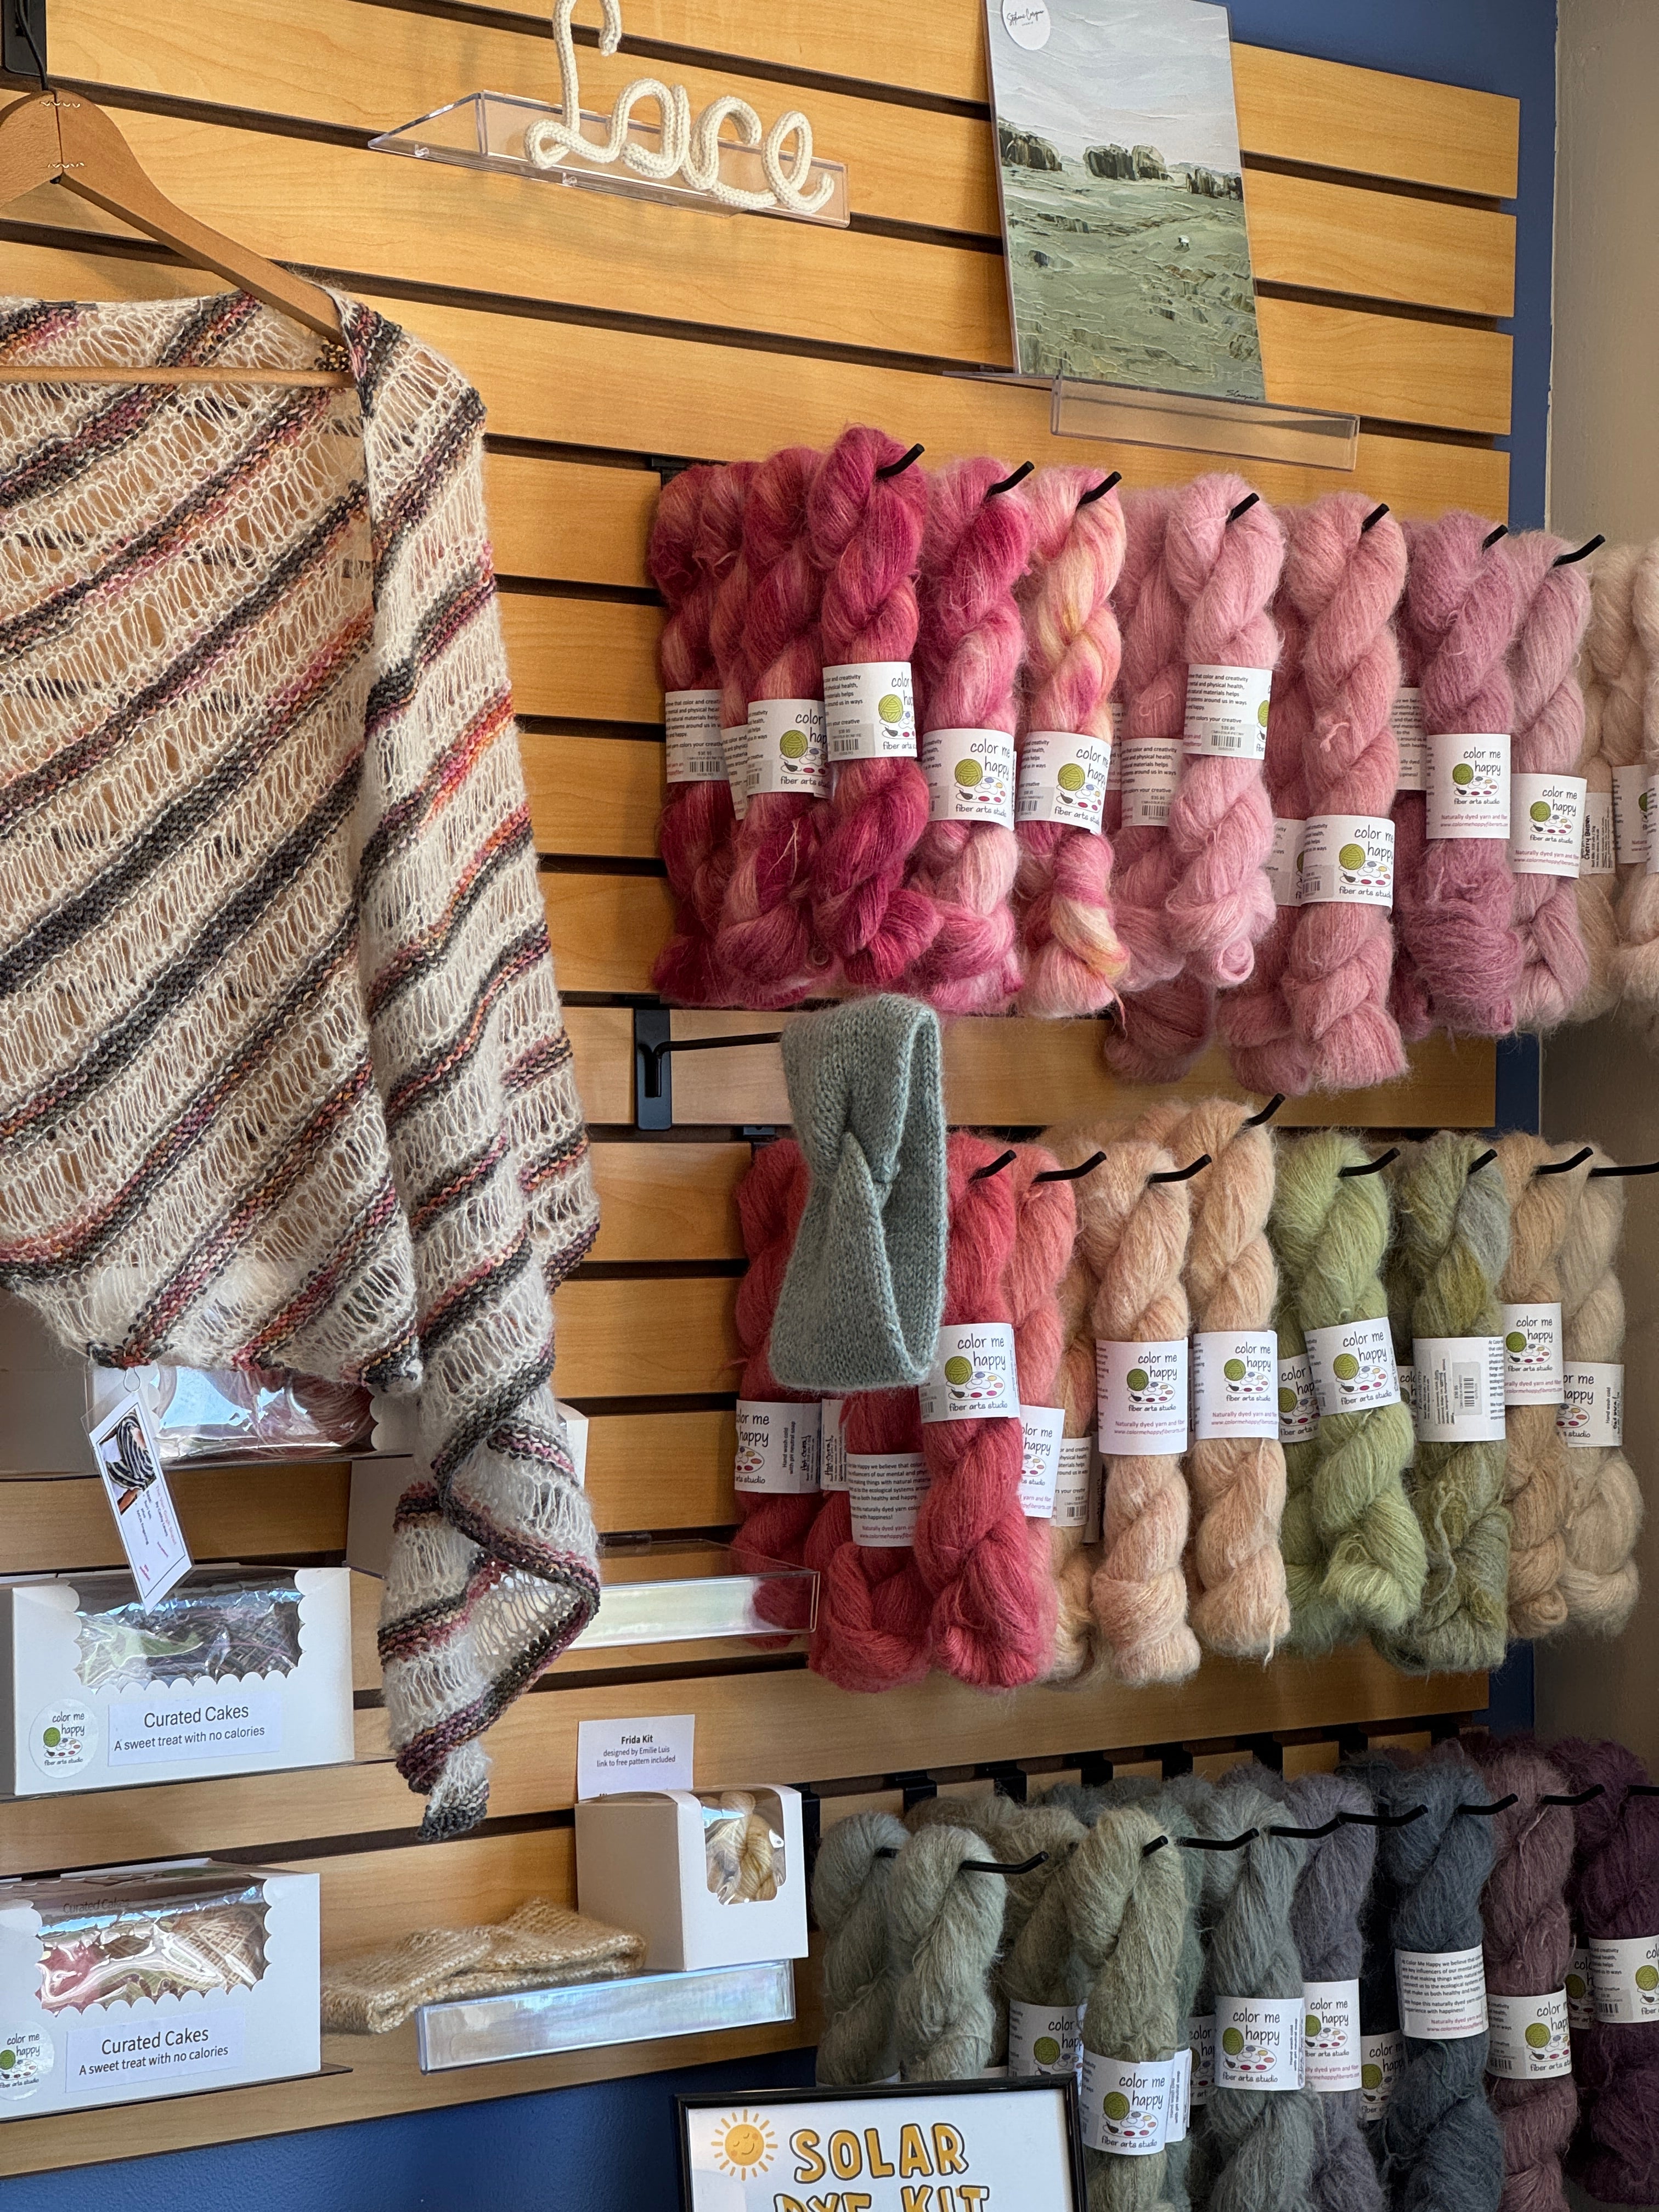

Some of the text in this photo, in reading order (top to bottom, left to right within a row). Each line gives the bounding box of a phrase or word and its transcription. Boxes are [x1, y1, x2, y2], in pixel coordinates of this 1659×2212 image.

[524, 0, 834, 213] Lace
[795, 709, 823, 725] color
[970, 738, 998, 754] color
[1464, 747, 1486, 759] color
[984, 755, 1009, 781] happy
[1475, 760, 1500, 776] happy
[781, 776, 816, 786] fiber arts
[1542, 786, 1577, 799] color me
[956, 804, 992, 814] fiber arts
[1553, 799, 1576, 816] happy
[1355, 824, 1381, 839] color
[1339, 886, 1356, 894] fiber
[1516, 1316, 1538, 1327] color
[958, 1333, 1005, 1350] color me
[1343, 1331, 1384, 1347] color me
[1527, 1329, 1553, 1342] happy
[1235, 1341, 1257, 1354] color
[1358, 1347, 1387, 1363] happy
[973, 1351, 1006, 1370] happy
[1138, 1351, 1161, 1364] color
[1247, 1356, 1271, 1372] happy
[1150, 1365, 1177, 1381] happy
[1578, 1375, 1594, 1384] me
[1375, 1390, 1392, 1399] studio
[988, 1401, 1008, 1409] studio
[753, 1415, 769, 1425] me
[740, 1425, 769, 1447] happy
[52, 1712, 71, 1723] color
[144, 1705, 249, 1728] Curated Cakes
[61, 1724, 84, 1736] happy
[114, 1726, 265, 1751] A sweet treat with no calories
[622, 1735, 653, 1744] Frida Kit
[629, 1757, 650, 1767] pattern
[63, 1901, 101, 1914] Curated
[1311, 1997, 1333, 2010] color
[1233, 2007, 1280, 2023] color me
[1322, 2011, 1348, 2026] happy
[1048, 2016, 1075, 2031] color
[7, 2033, 40, 2045] color me
[102, 2028, 209, 2055] Curated Cakes
[1245, 2024, 1279, 2046] happy
[16, 2045, 40, 2057] happy
[79, 2046, 228, 2075] A sweet treat with no calories
[1119, 2073, 1165, 2088] color me
[1223, 2072, 1237, 2081] fiber
[1132, 2090, 1163, 2111] happy
[1102, 2136, 1119, 2146] fiber
[1138, 2139, 1157, 2148] studio
[789, 2123, 969, 2185] SOLAR
